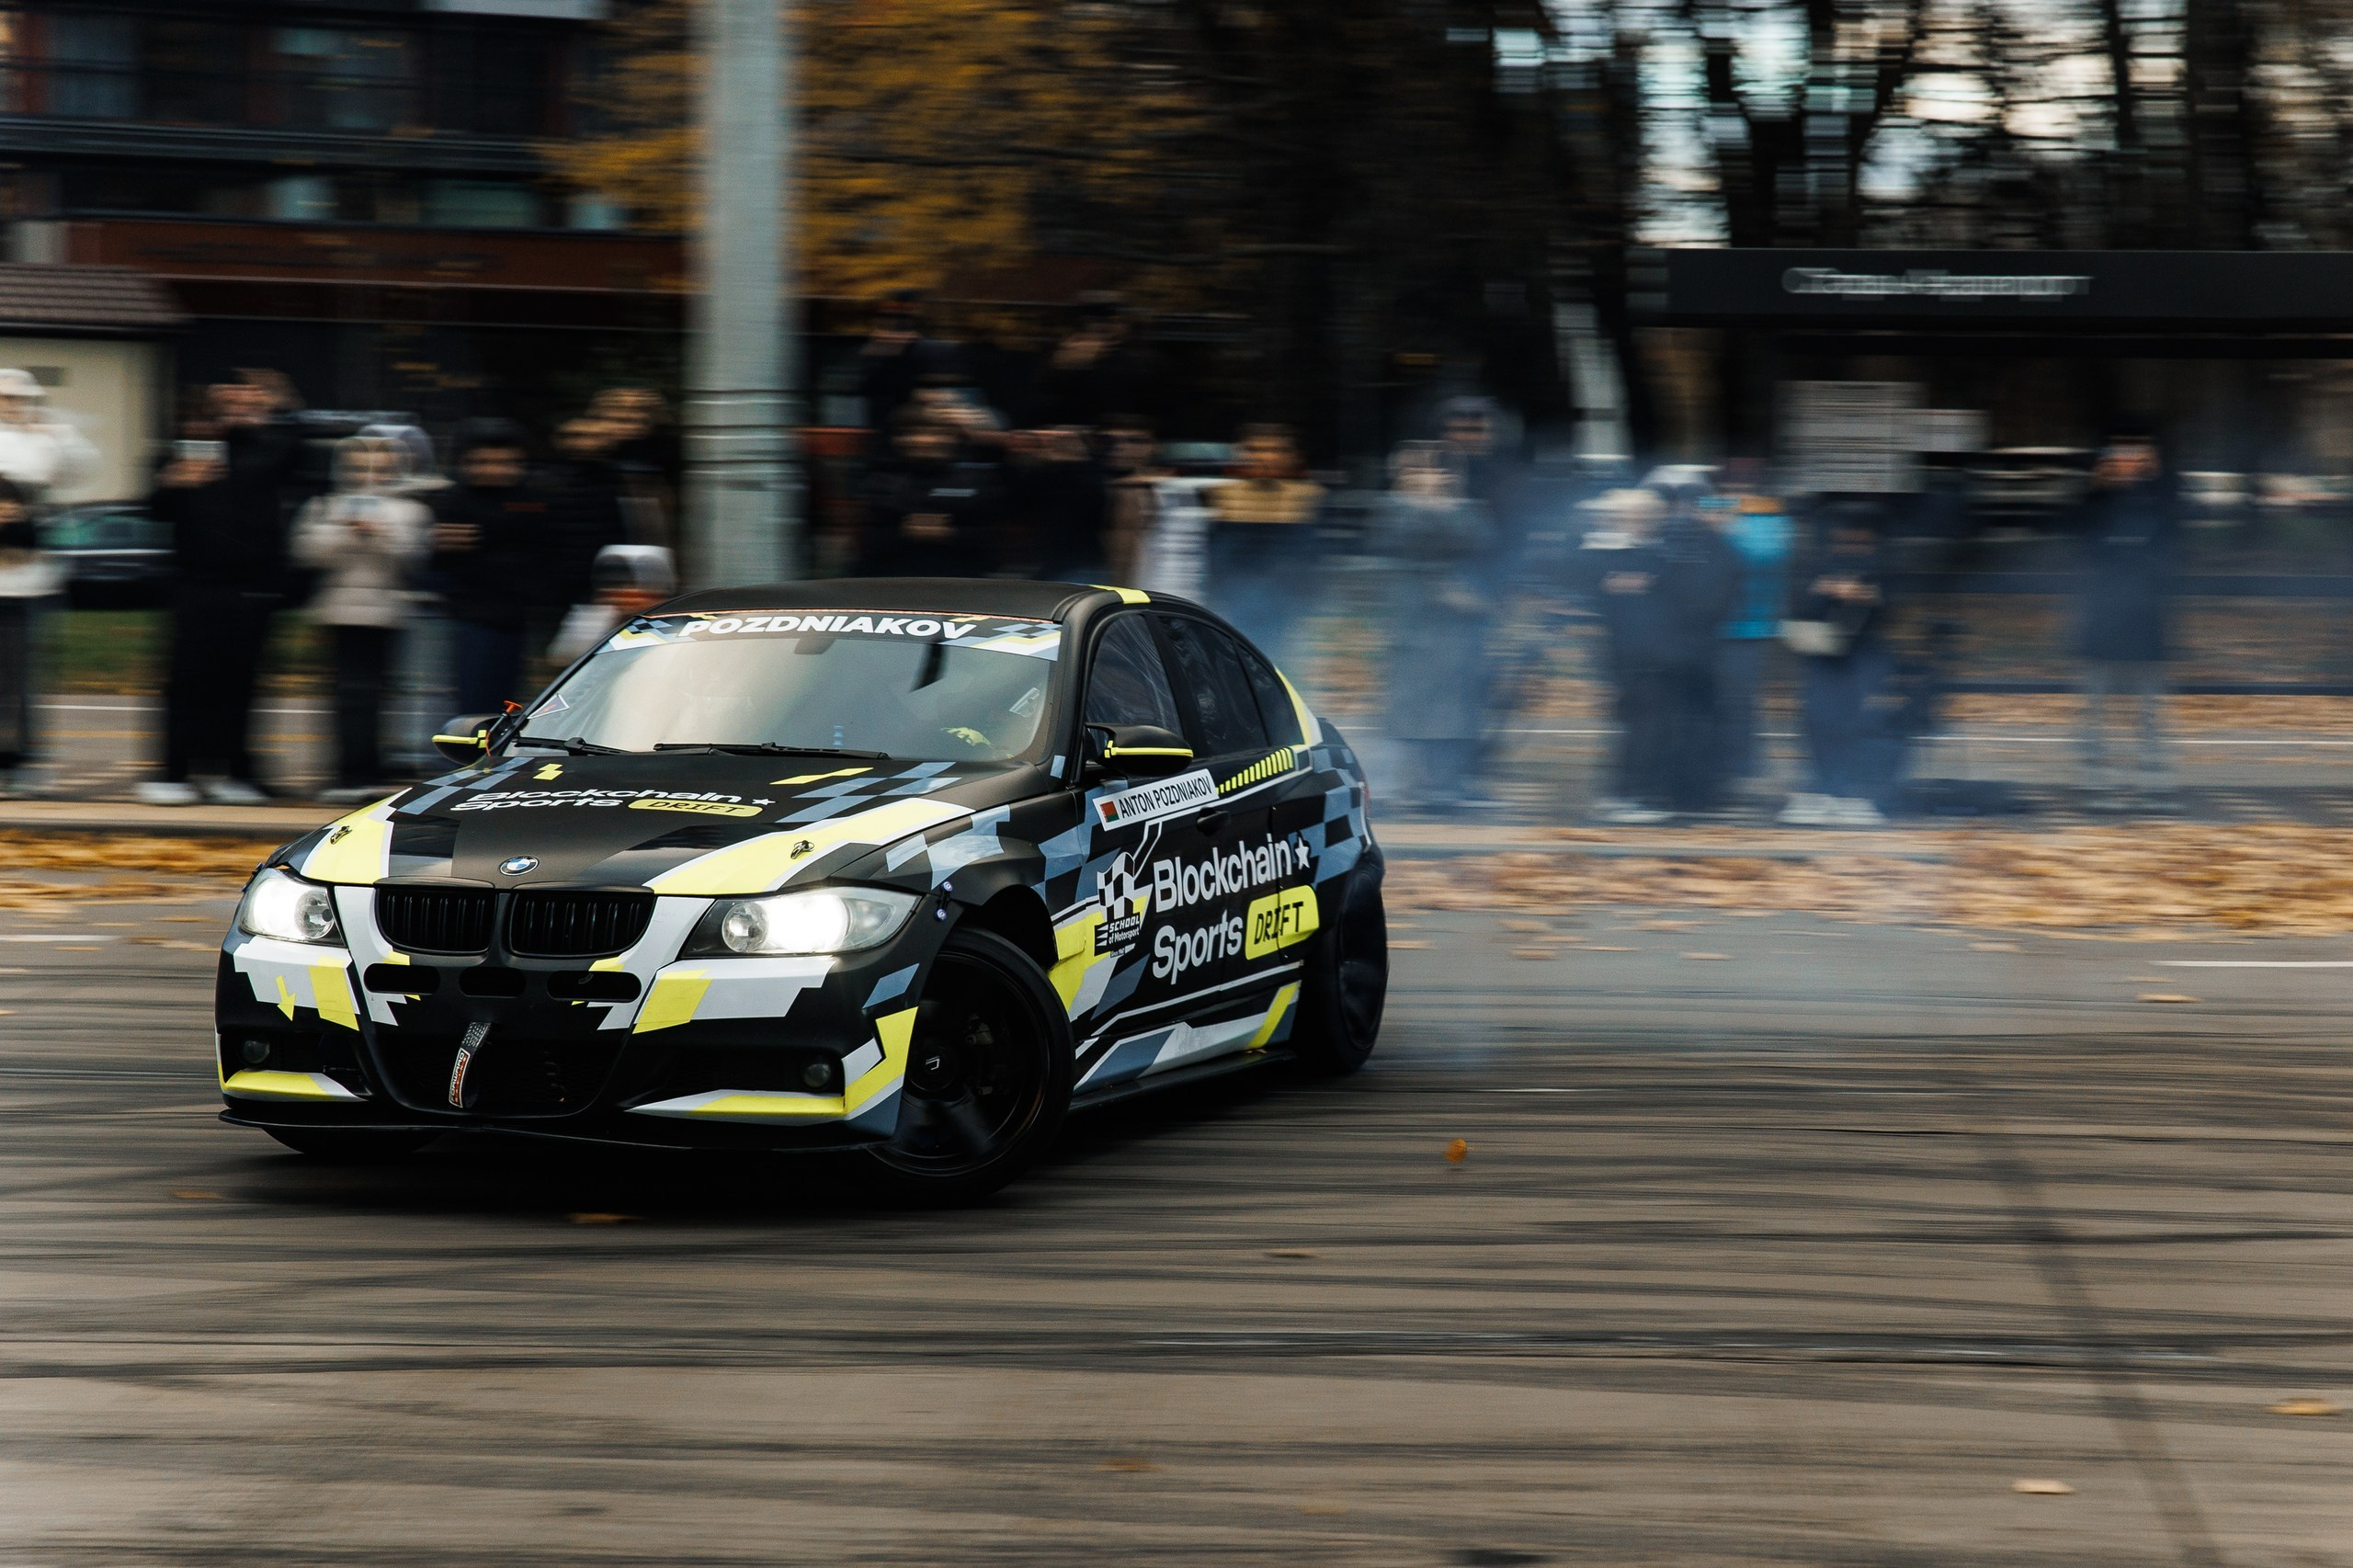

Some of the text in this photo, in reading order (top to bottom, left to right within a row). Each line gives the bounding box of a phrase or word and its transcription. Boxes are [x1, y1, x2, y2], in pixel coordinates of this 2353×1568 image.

[678, 616, 976, 638] POZDNIAKOV
[450, 798, 746, 813] Sports DRIFT
[472, 789, 742, 803] Blockchain
[1119, 778, 1212, 818] ANTON POZDNIAKOV
[1154, 834, 1291, 913] Blockchain
[1108, 915, 1140, 933] SCHOOL
[1108, 926, 1140, 945] of Motorsport
[1153, 901, 1304, 985] Sports DRIFT
